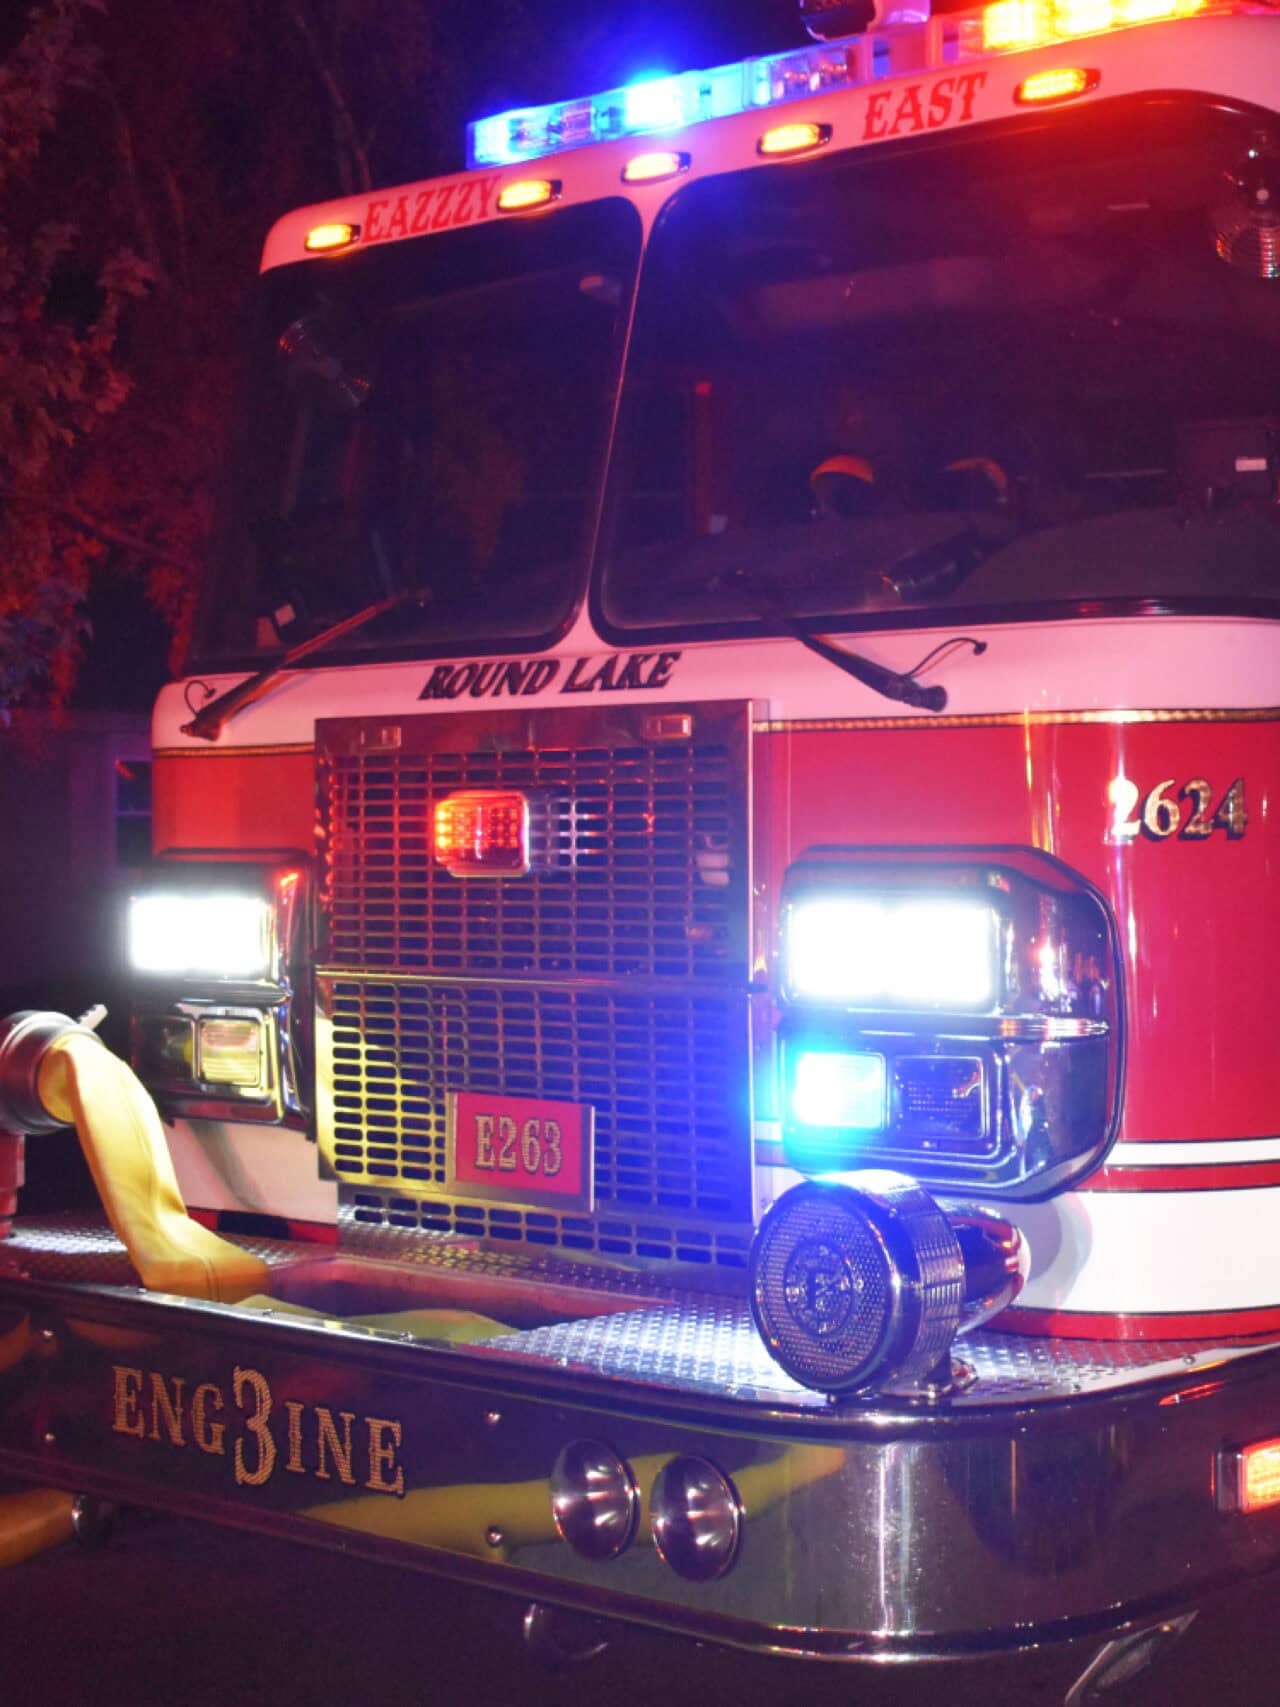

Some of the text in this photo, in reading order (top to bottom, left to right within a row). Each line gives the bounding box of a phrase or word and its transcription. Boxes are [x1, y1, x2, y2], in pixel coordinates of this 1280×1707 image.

[862, 71, 988, 140] EAST
[361, 175, 501, 243] EAZZZY
[418, 652, 681, 700] ROUND LAKE
[1108, 777, 1248, 841] 2624
[474, 1112, 562, 1177] E263
